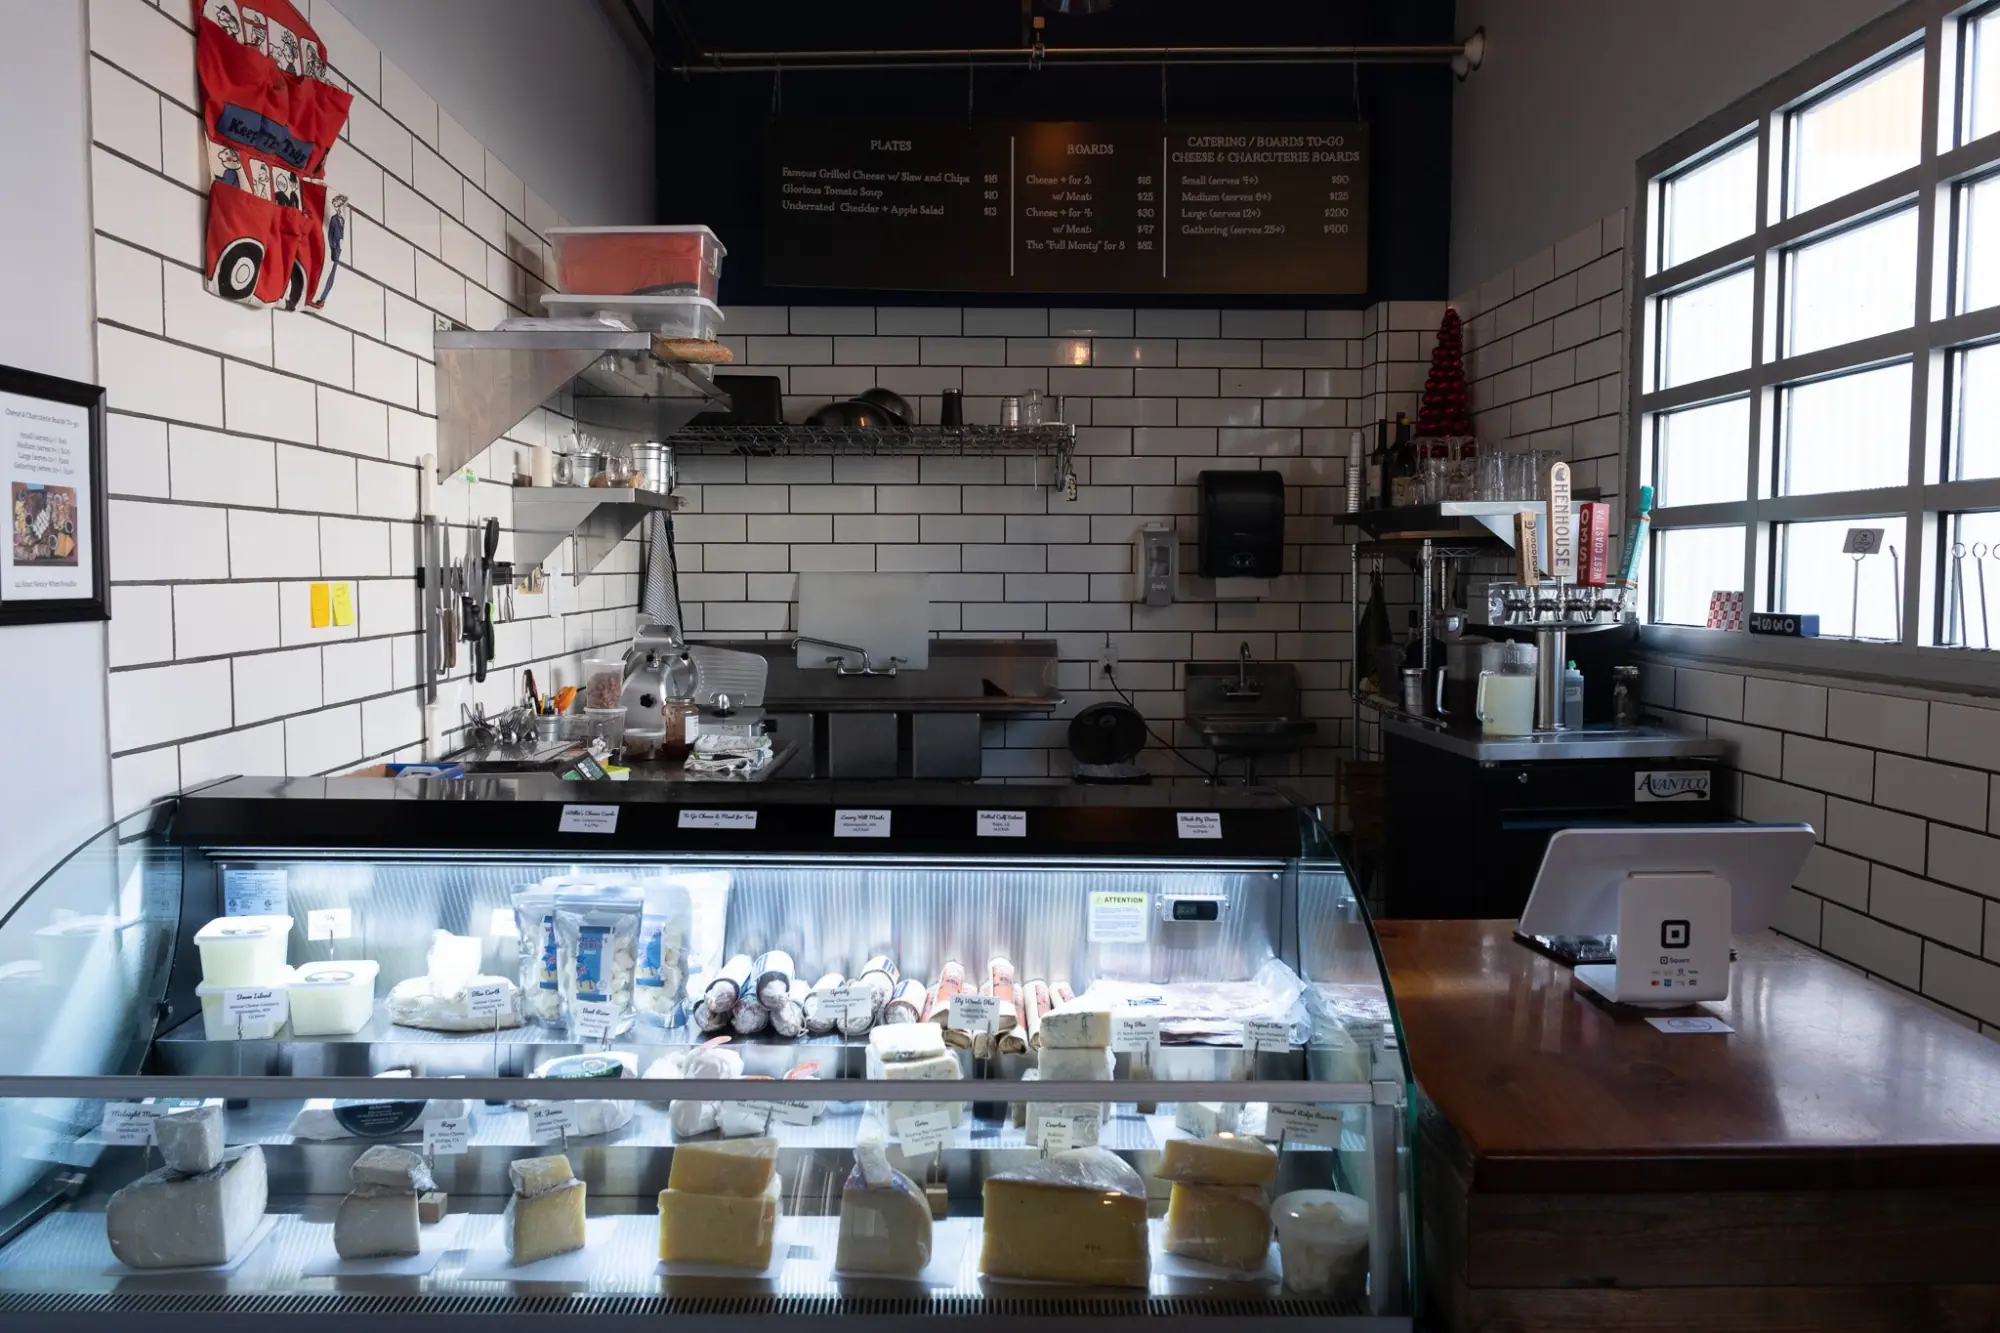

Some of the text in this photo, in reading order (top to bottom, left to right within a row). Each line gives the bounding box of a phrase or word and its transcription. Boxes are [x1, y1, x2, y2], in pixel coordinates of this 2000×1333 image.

[871, 139, 913, 152] PLATES
[1187, 136, 1344, 147] CATERING / BOARDS TO-GO
[1067, 144, 1114, 155] BOARDS
[1172, 152, 1360, 163] CHEESE & CHARCUTERIE BOARDS
[782, 167, 970, 185] Famous Grilled Cheese w/ Slaw and Chips
[1026, 175, 1058, 185] Cheese
[1068, 175, 1081, 185] for
[1182, 176, 1206, 185] Small
[1208, 175, 1239, 186] (serves
[1331, 175, 1350, 184] $90
[782, 183, 883, 199] Glorious Tomato Soup
[983, 190, 998, 200] $10
[1052, 192, 1064, 201] w/
[1182, 192, 1219, 201] Medium
[1221, 192, 1253, 202] (serves
[1329, 192, 1349, 201] $125
[782, 200, 836, 212] Underrated
[839, 201, 879, 213] Cheddar
[891, 205, 918, 217] Apple
[920, 205, 945, 216] Salad
[983, 206, 997, 216] $13
[1026, 207, 1058, 217] Cheese
[1068, 208, 1081, 217] for
[1137, 208, 1154, 218] $30
[1324, 209, 1349, 218] $200
[1181, 208, 1207, 221] Large
[1208, 208, 1241, 219] (serves
[1052, 224, 1064, 233] w/
[1182, 224, 1285, 237] Gathering (serves 25+)
[1026, 240, 1044, 249] The
[1103, 241, 1116, 250] for
[1118, 241, 1125, 250] 8
[1554, 482, 1571, 568] HENHOUSE
[1593, 508, 1606, 581] WEST COAST IPA
[1637, 774, 1708, 796] AVANTCO
[1104, 896, 1143, 904] ATTENTION
[253, 991, 272, 1000] Island
[485, 987, 500, 996] Earth
[1249, 1021, 1270, 1030] Original
[111, 1109, 161, 1120] Midnight Moon
[1272, 1106, 1297, 1116] Pleasant
[1297, 1110, 1314, 1120] Ridge
